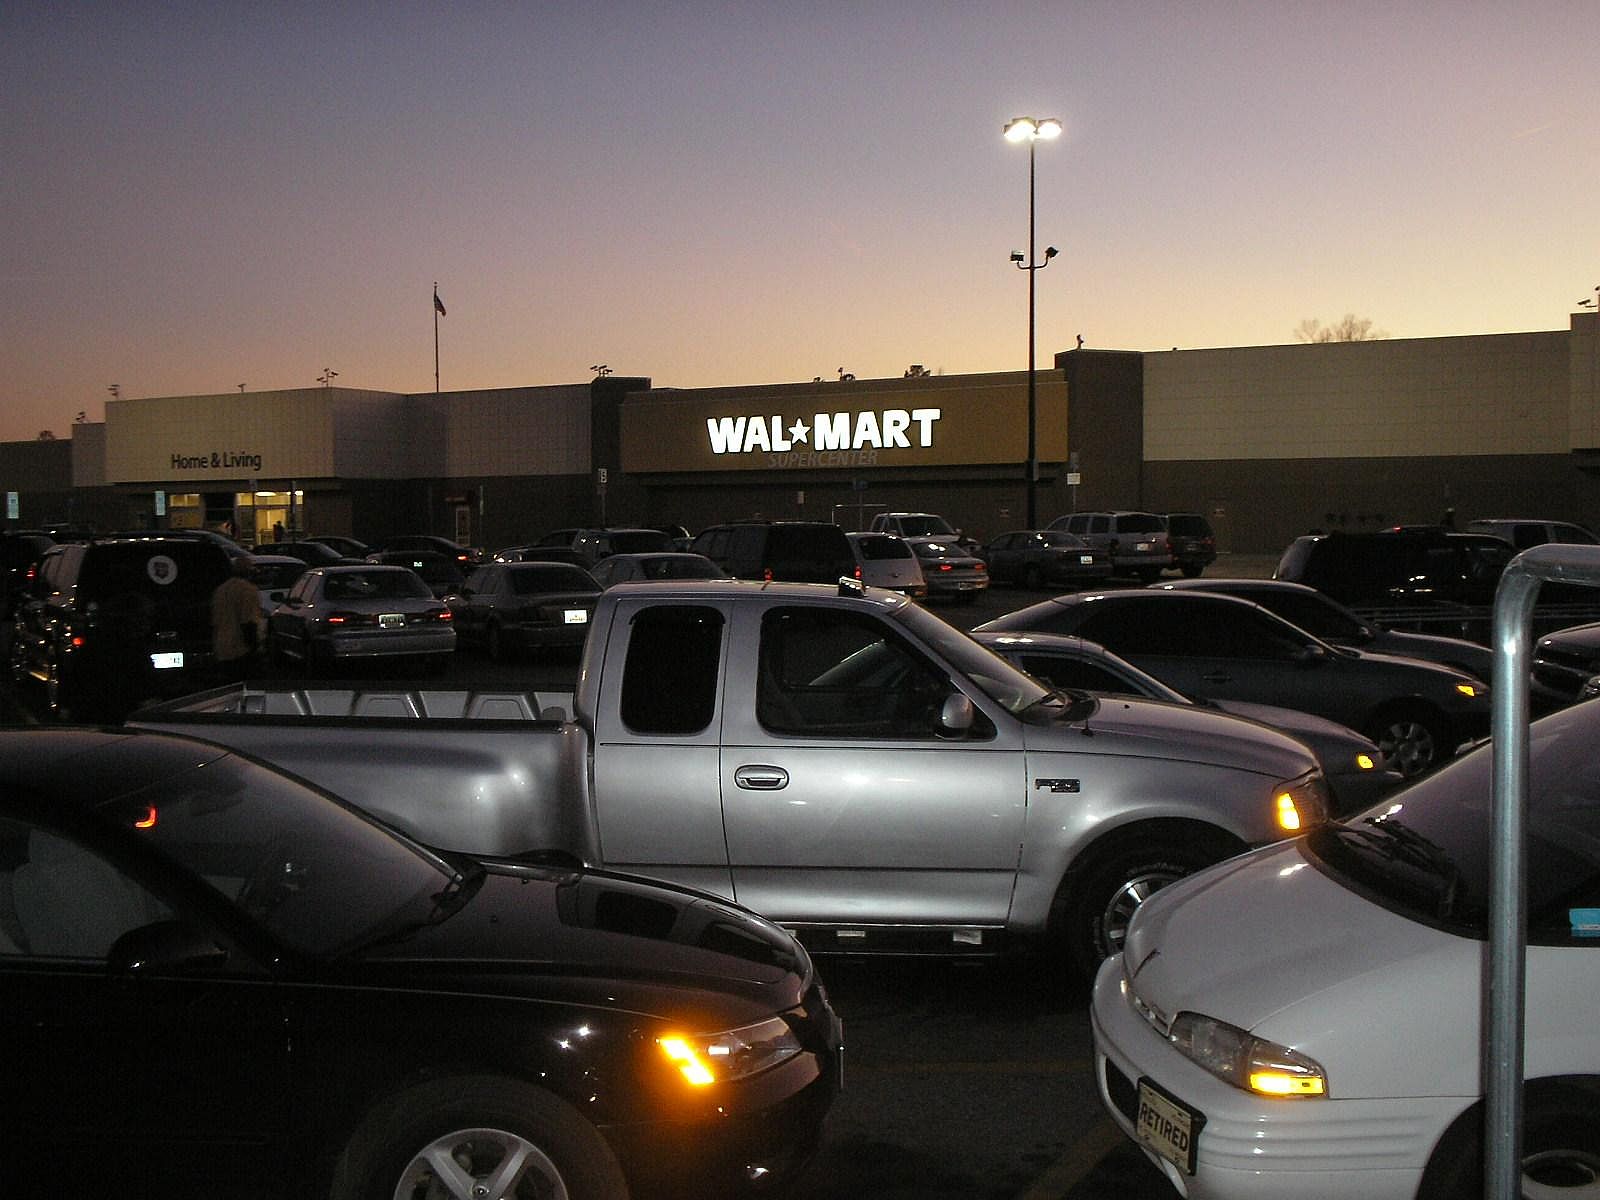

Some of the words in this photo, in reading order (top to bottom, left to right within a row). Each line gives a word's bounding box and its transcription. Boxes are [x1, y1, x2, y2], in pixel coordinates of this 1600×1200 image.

[171, 453, 208, 469] Home
[210, 452, 221, 468] &
[223, 451, 261, 470] Living
[768, 450, 878, 468] SUPERCENTER
[1139, 1102, 1189, 1152] RETIRED
